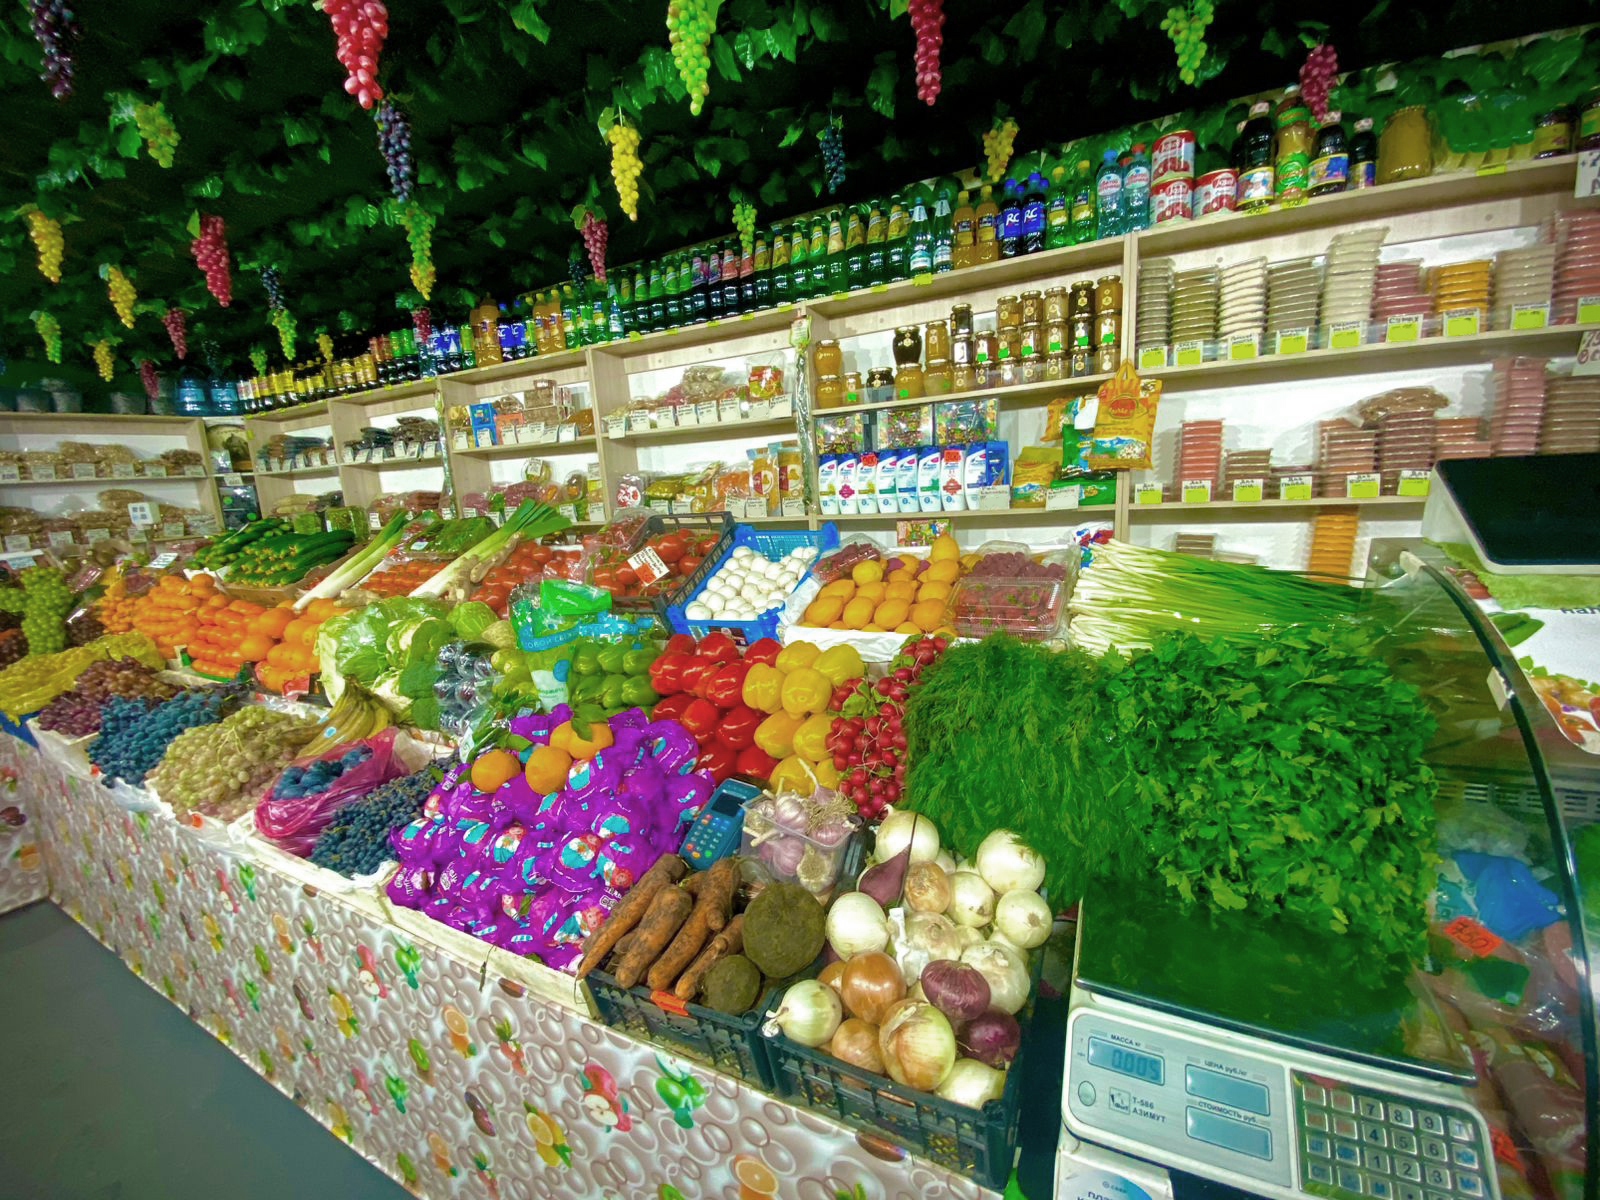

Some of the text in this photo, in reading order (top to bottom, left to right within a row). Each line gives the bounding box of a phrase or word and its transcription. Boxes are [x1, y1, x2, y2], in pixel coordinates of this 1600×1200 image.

[1006, 213, 1019, 226] RC
[1024, 208, 1037, 223] RC
[1110, 1034, 1134, 1045] МАССА
[1204, 1059, 1224, 1071] ЦЕНА
[1132, 1107, 1167, 1123] АЗИМУТ
[1198, 1101, 1243, 1119] СТОИМОСТЬ
[1366, 1103, 1375, 1116] 7
[1394, 1109, 1404, 1123] 8
[1424, 1116, 1434, 1129] 9
[1369, 1129, 1379, 1142] 4
[1399, 1136, 1409, 1149] 5
[1429, 1143, 1440, 1156] 6
[1374, 1156, 1381, 1169] 1
[1402, 1162, 1413, 1176] 2
[1432, 1170, 1442, 1183] 3
